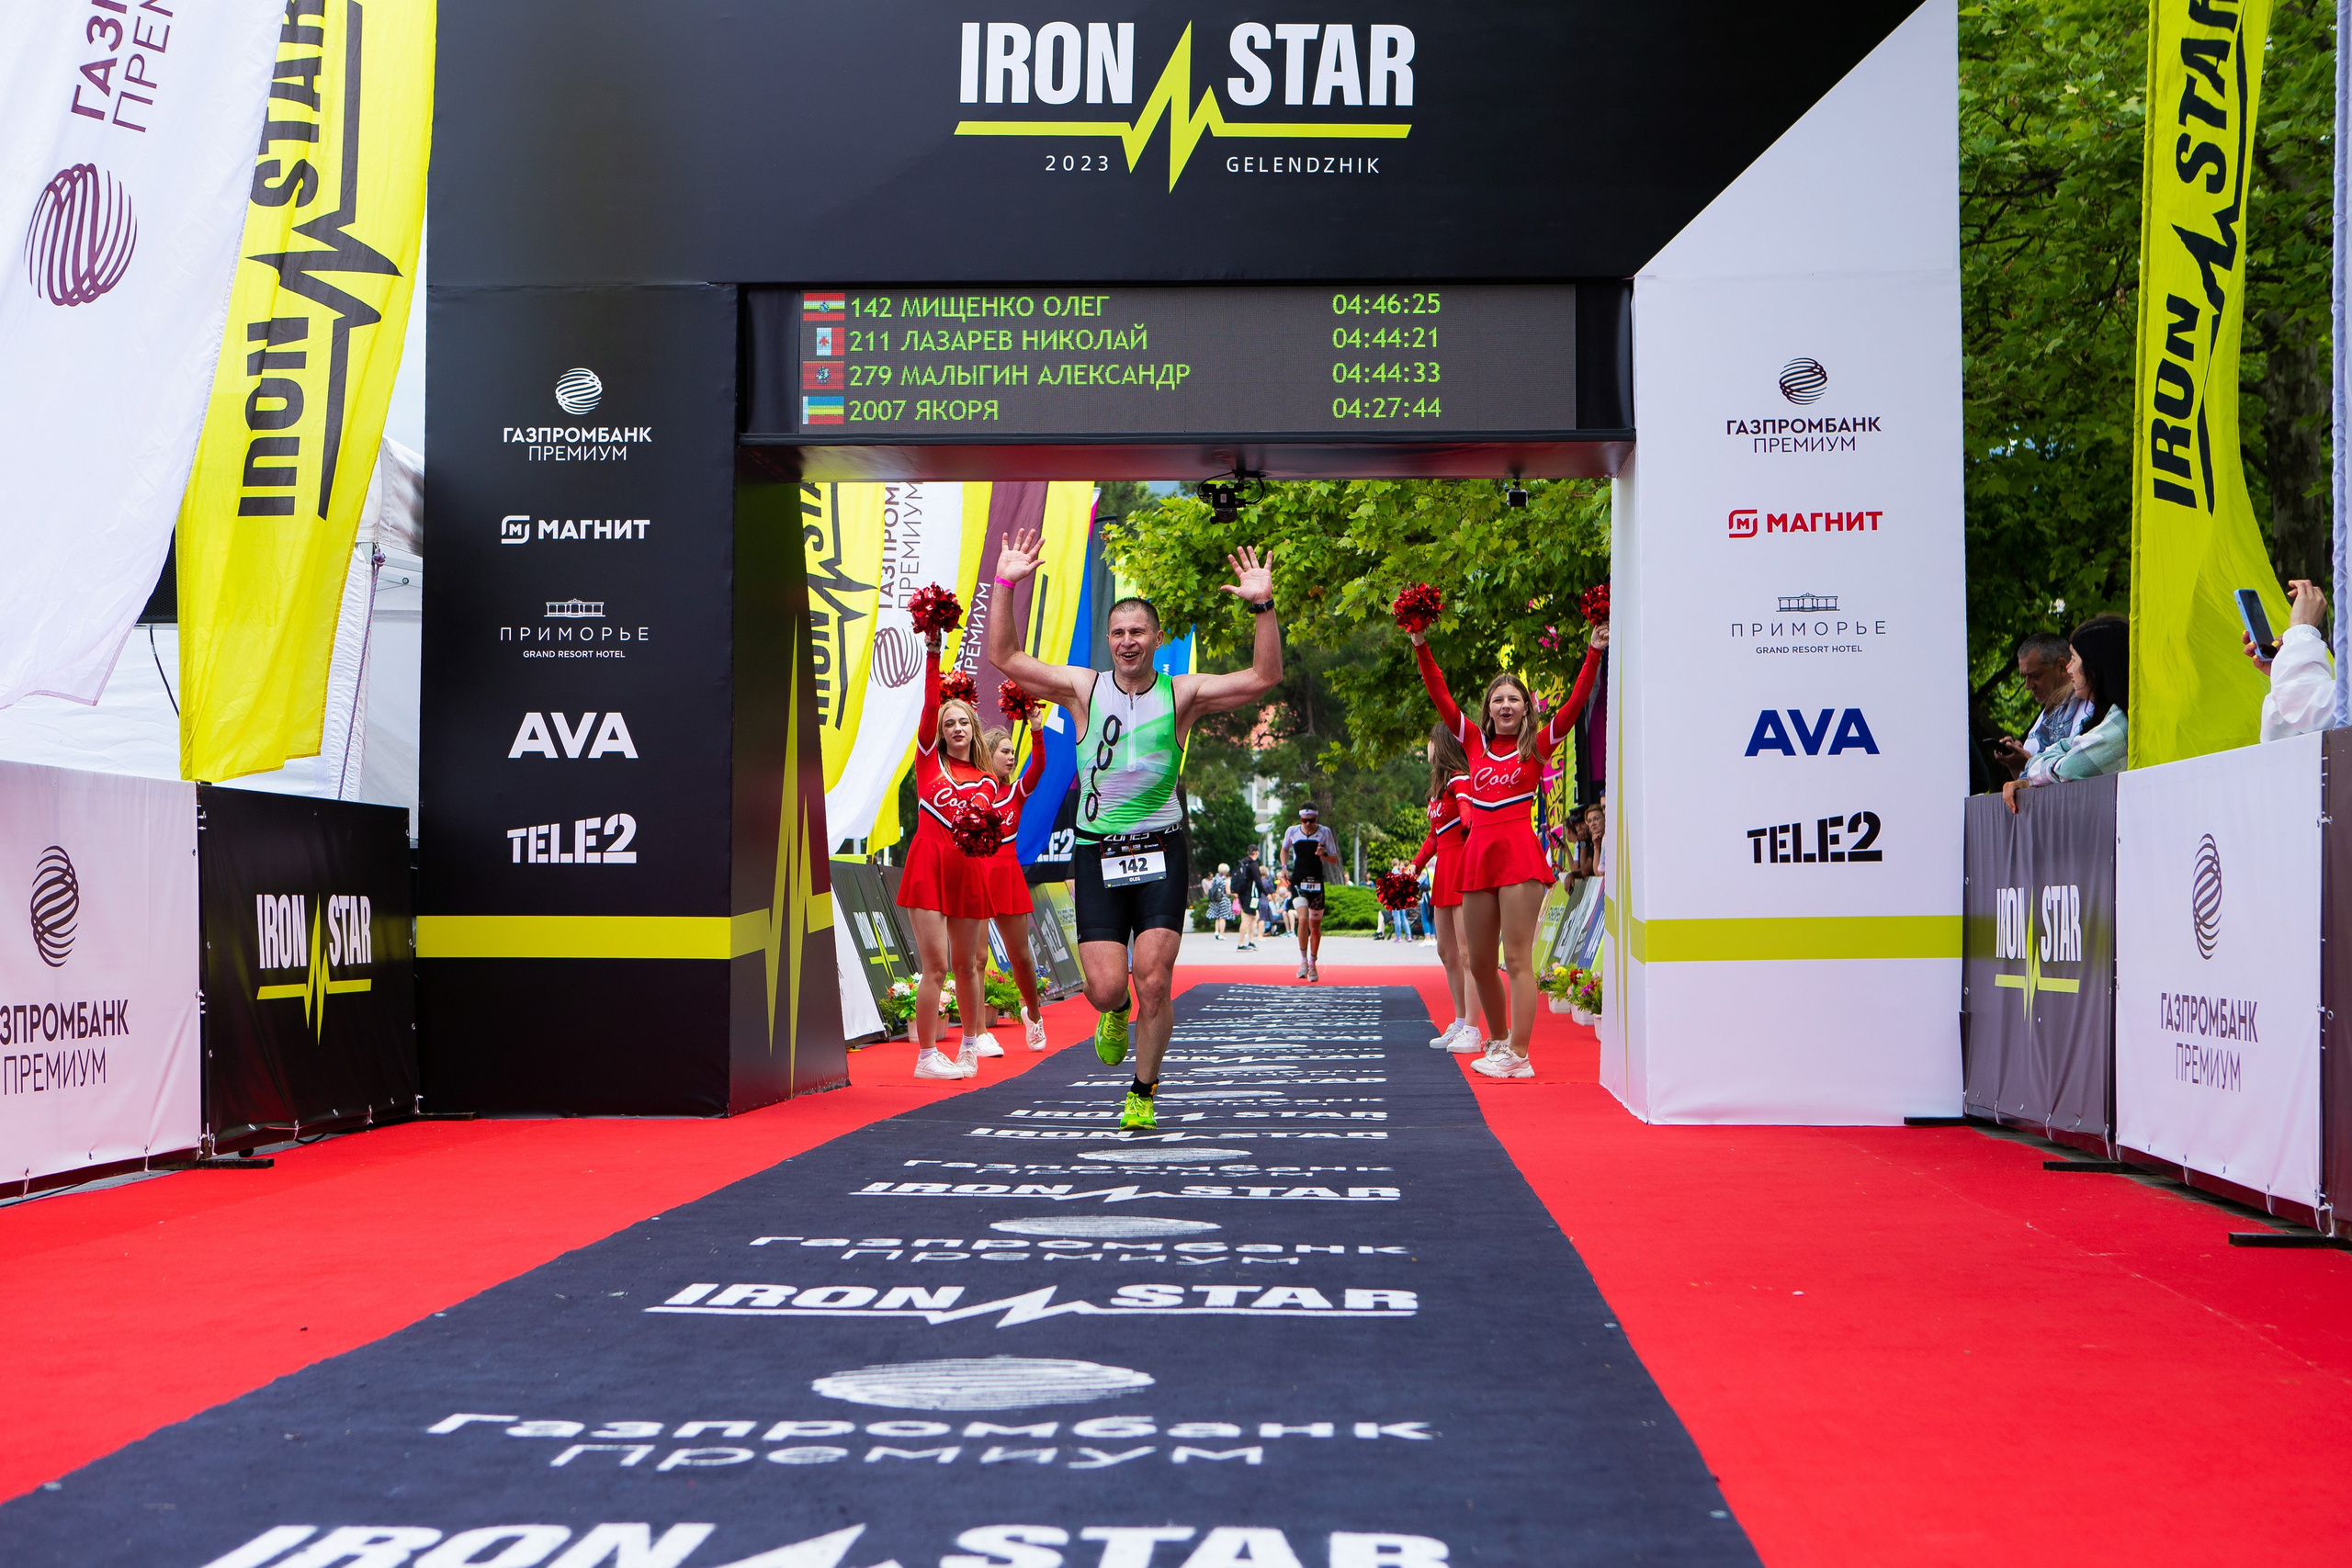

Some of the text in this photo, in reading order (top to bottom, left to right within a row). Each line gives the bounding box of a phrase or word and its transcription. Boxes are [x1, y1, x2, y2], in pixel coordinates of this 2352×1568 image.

[960, 22, 1416, 106] IRON STAR
[1046, 155, 1379, 174] 2023 GELENDZHIK
[851, 293, 1441, 322] 142 МИЩЕНКО ОЛЕГ 04:46:25
[849, 323, 1438, 352] 211 ЛАЗАРЕВ НИКОЛАЙ 04:44:21
[849, 362, 1441, 390] 279 МАЛЫГИН АЛЕКСАНДР 04:44:33
[848, 398, 1442, 421] 2007 ЯКОРЯ 04:27:44
[2151, 293, 2199, 508] IRON
[503, 427, 652, 443] ГАЗПРОМБАНК
[1726, 416, 1882, 435] ГАЗПРОМБАНК
[528, 446, 627, 461] ПРЕМИУМ
[1754, 436, 1856, 454] ПРЕМИУМ
[537, 520, 650, 540] МАГНИТ
[1767, 511, 1883, 533] МАГНИТ
[500, 626, 649, 641] ПРИМОРЬЕ
[1731, 620, 1886, 637] ПРИМОРЬЕ
[523, 650, 626, 659] GRAND RESORT HOTEL
[1792, 646, 1829, 654] RESORT
[1832, 645, 1863, 653] HOTEL
[508, 712, 639, 759] AVA
[1744, 708, 1881, 757] AVA
[1085, 714, 1123, 822] orca
[1474, 767, 1521, 791] Cool
[507, 813, 637, 863] TELE2
[1747, 810, 1883, 864] TELE2
[1118, 857, 1148, 874] 142
[256, 894, 371, 969] IRON STAR
[1996, 885, 2082, 962] IRON STAR
[2160, 992, 2258, 1043] ГАЗПРОМБАНК
[4, 1047, 106, 1095] ПРЕМИУМ
[2175, 1043, 2242, 1092] ПРЕМИУМ
[1233, 1111, 1388, 1119] STAR
[970, 1127, 1134, 1138] IRON
[861, 1181, 1401, 1198] IRON STAR
[748, 1235, 1408, 1255] Газпромбанк
[840, 1248, 1299, 1266] Премиум
[663, 1282, 1419, 1310] IRON STAR
[425, 1413, 1435, 1441] Газпромбанк
[549, 1444, 1262, 1472] Премиум
[198, 1521, 716, 1568] IRON
